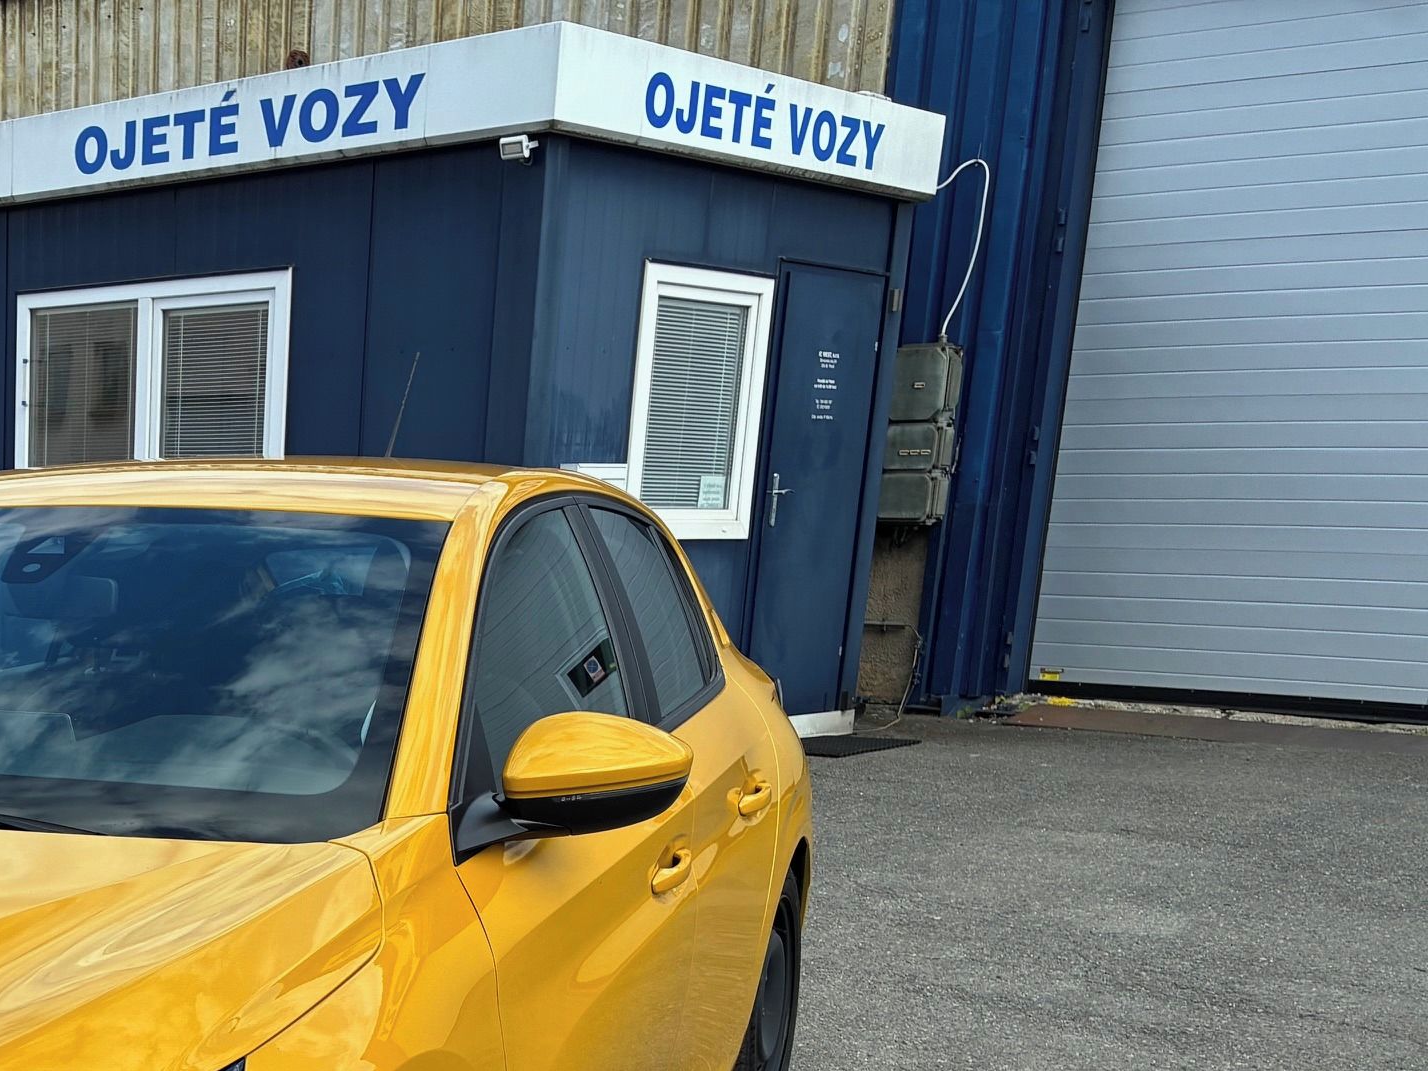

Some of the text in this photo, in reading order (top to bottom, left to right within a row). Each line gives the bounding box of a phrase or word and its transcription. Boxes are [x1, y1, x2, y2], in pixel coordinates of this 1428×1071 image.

[74, 72, 426, 175] OJETÉ VOZY
[645, 71, 886, 170] OJETÉ VOZY
